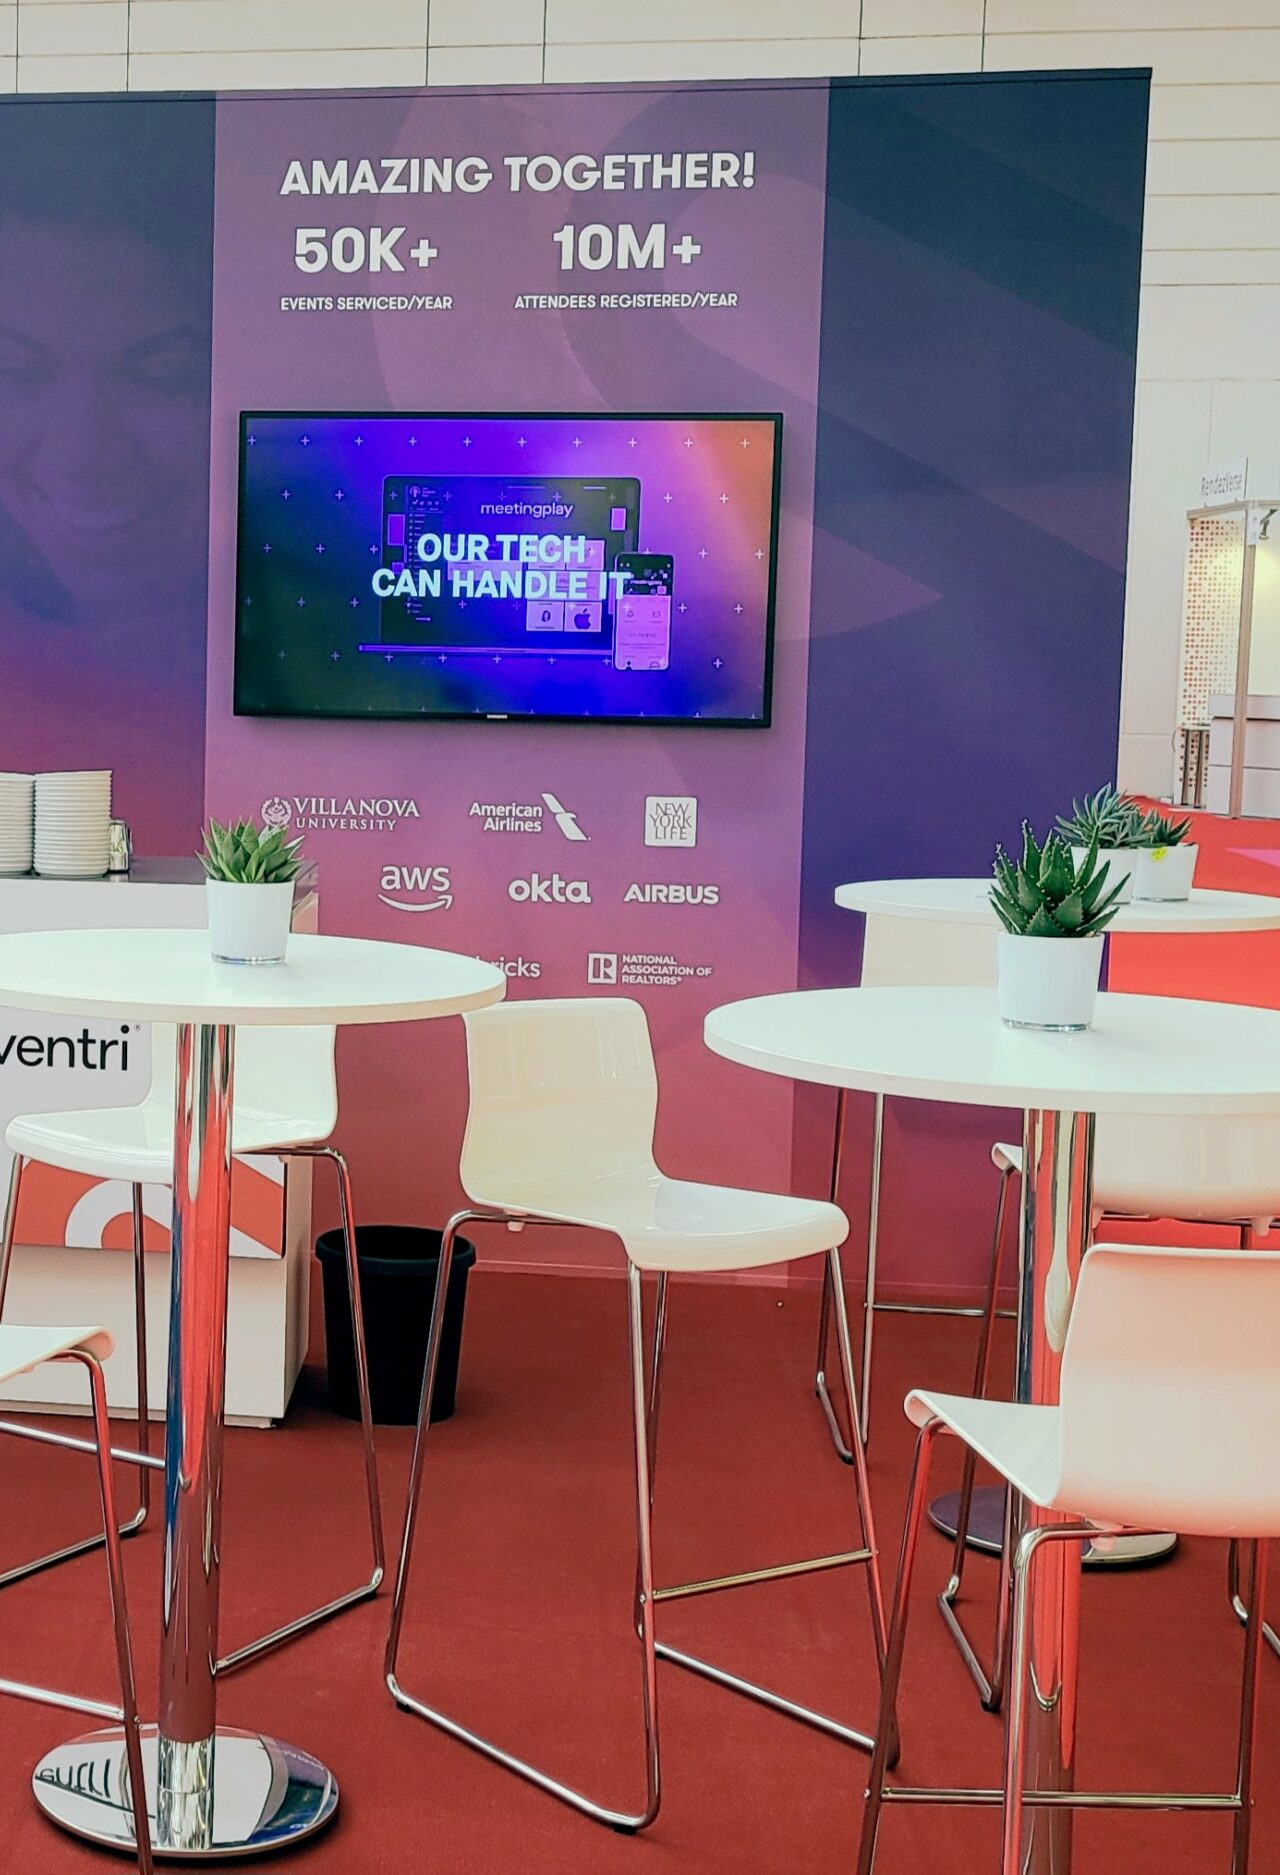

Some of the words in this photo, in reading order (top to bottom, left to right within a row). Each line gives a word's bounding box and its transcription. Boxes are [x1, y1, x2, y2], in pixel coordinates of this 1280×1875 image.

[279, 156, 493, 195] AMAZING
[503, 151, 756, 192] TOGETHER!
[293, 226, 439, 274] 50K+
[552, 222, 702, 271] 10M+
[280, 296, 334, 311] EVENTS
[336, 294, 453, 311] SERVICED/YEAR
[514, 294, 598, 310] ATTENDEES
[599, 291, 739, 309] REGISTERED/YEAR
[480, 501, 574, 519] meetingplay
[416, 532, 490, 562] OUR
[495, 534, 586, 564] TECH
[371, 568, 441, 598] CAN
[452, 569, 588, 599] HANDLE
[598, 570, 632, 600] IT
[293, 797, 421, 818] VILLANOVA
[469, 801, 543, 818] American
[655, 802, 689, 815] NEW
[296, 817, 397, 831] UNIVERSITY
[483, 817, 543, 833] Airlines
[649, 814, 692, 828] YORK
[654, 827, 688, 840] LIFE
[380, 865, 451, 892] aws
[508, 873, 592, 904] okta
[623, 883, 720, 905] AIRBUS
[621, 954, 678, 965] NATIONAL
[621, 964, 694, 976] ASSOCIATION
[696, 966, 713, 977] OF
